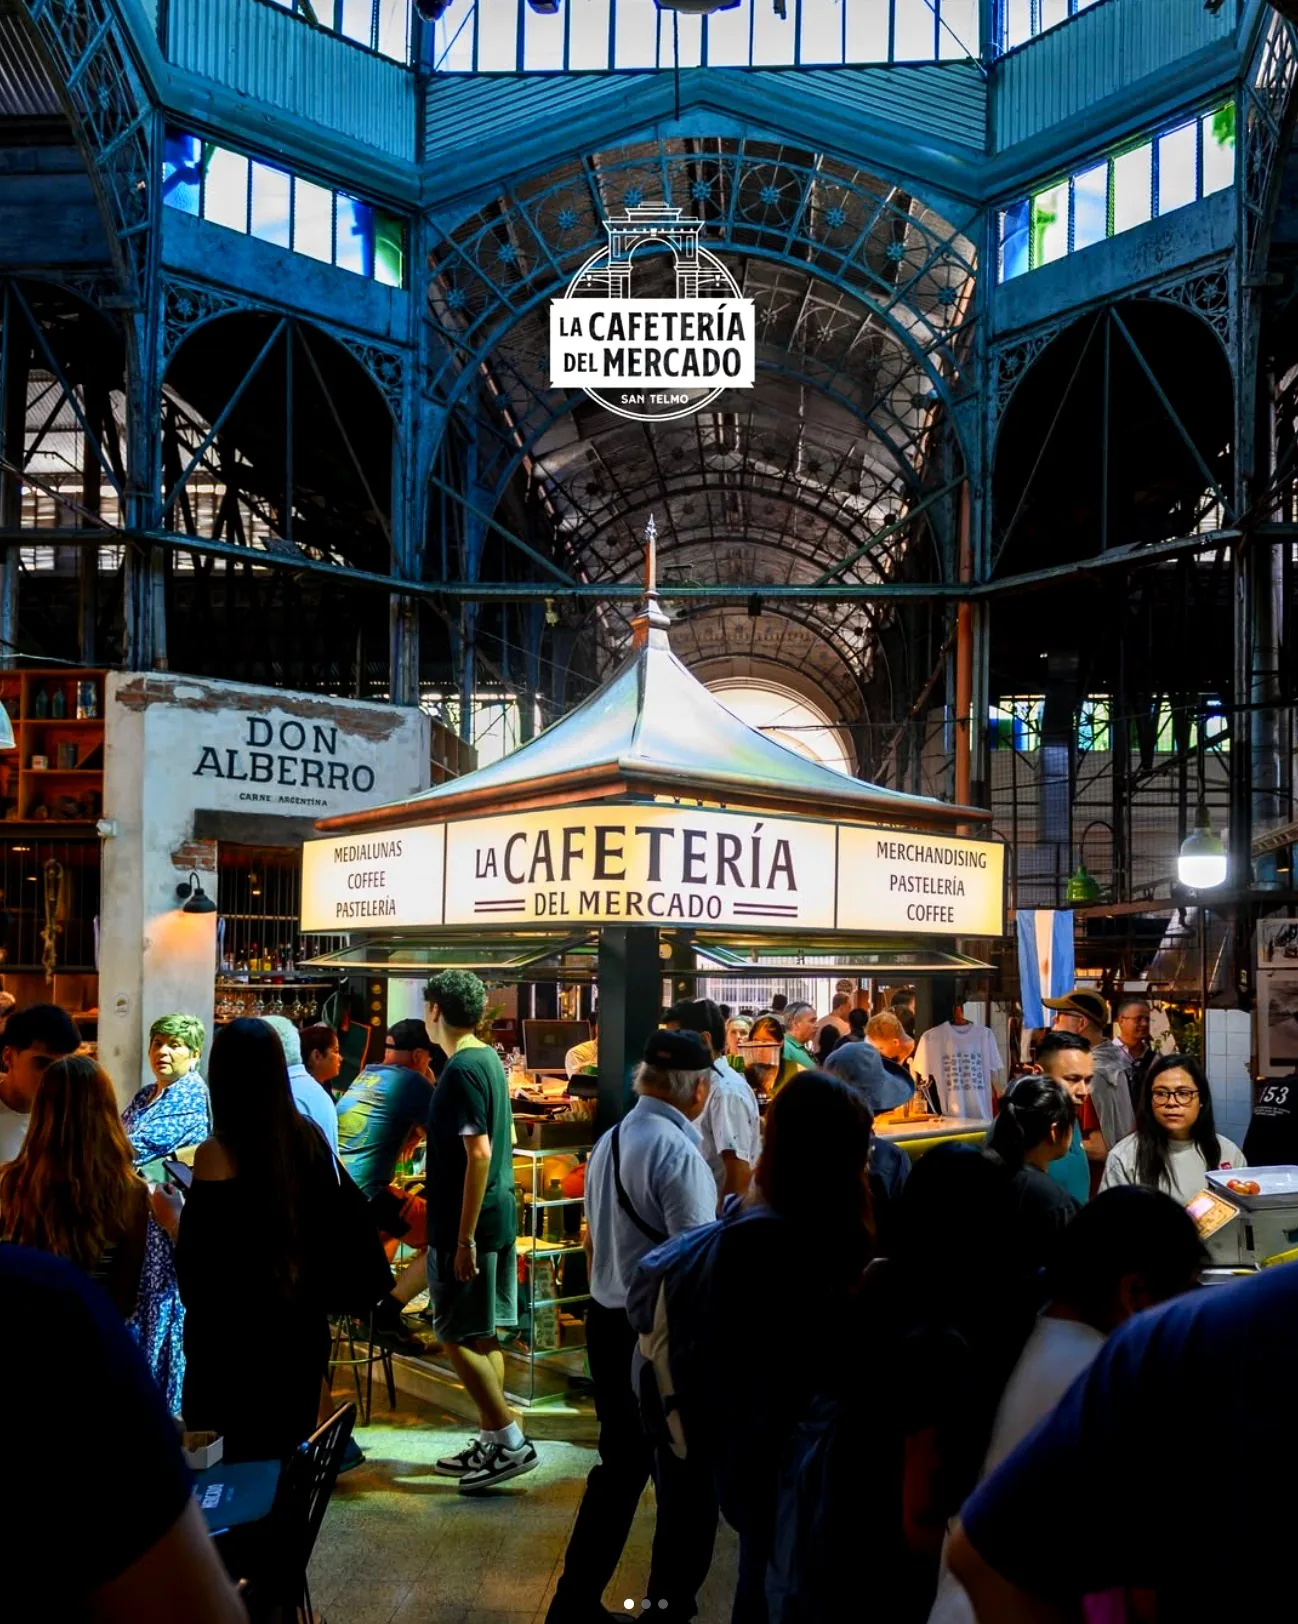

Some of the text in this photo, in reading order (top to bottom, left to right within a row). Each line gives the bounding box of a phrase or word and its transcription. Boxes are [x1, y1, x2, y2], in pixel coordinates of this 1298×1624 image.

[245, 715, 339, 756] DON
[192, 746, 376, 793] ALBERRO
[238, 792, 328, 807] CARNE ARGENTINA
[334, 839, 402, 863] MEDIALUNAS
[475, 822, 798, 891] LA CAFETERÍA
[877, 840, 987, 869] MERCHANDISING
[347, 870, 387, 890] COFFEE
[889, 874, 965, 897] PASTELERÍA
[335, 895, 396, 919] PASTELERÍA
[534, 890, 722, 920] DEL MERCADO
[906, 903, 955, 924] COFFEE
